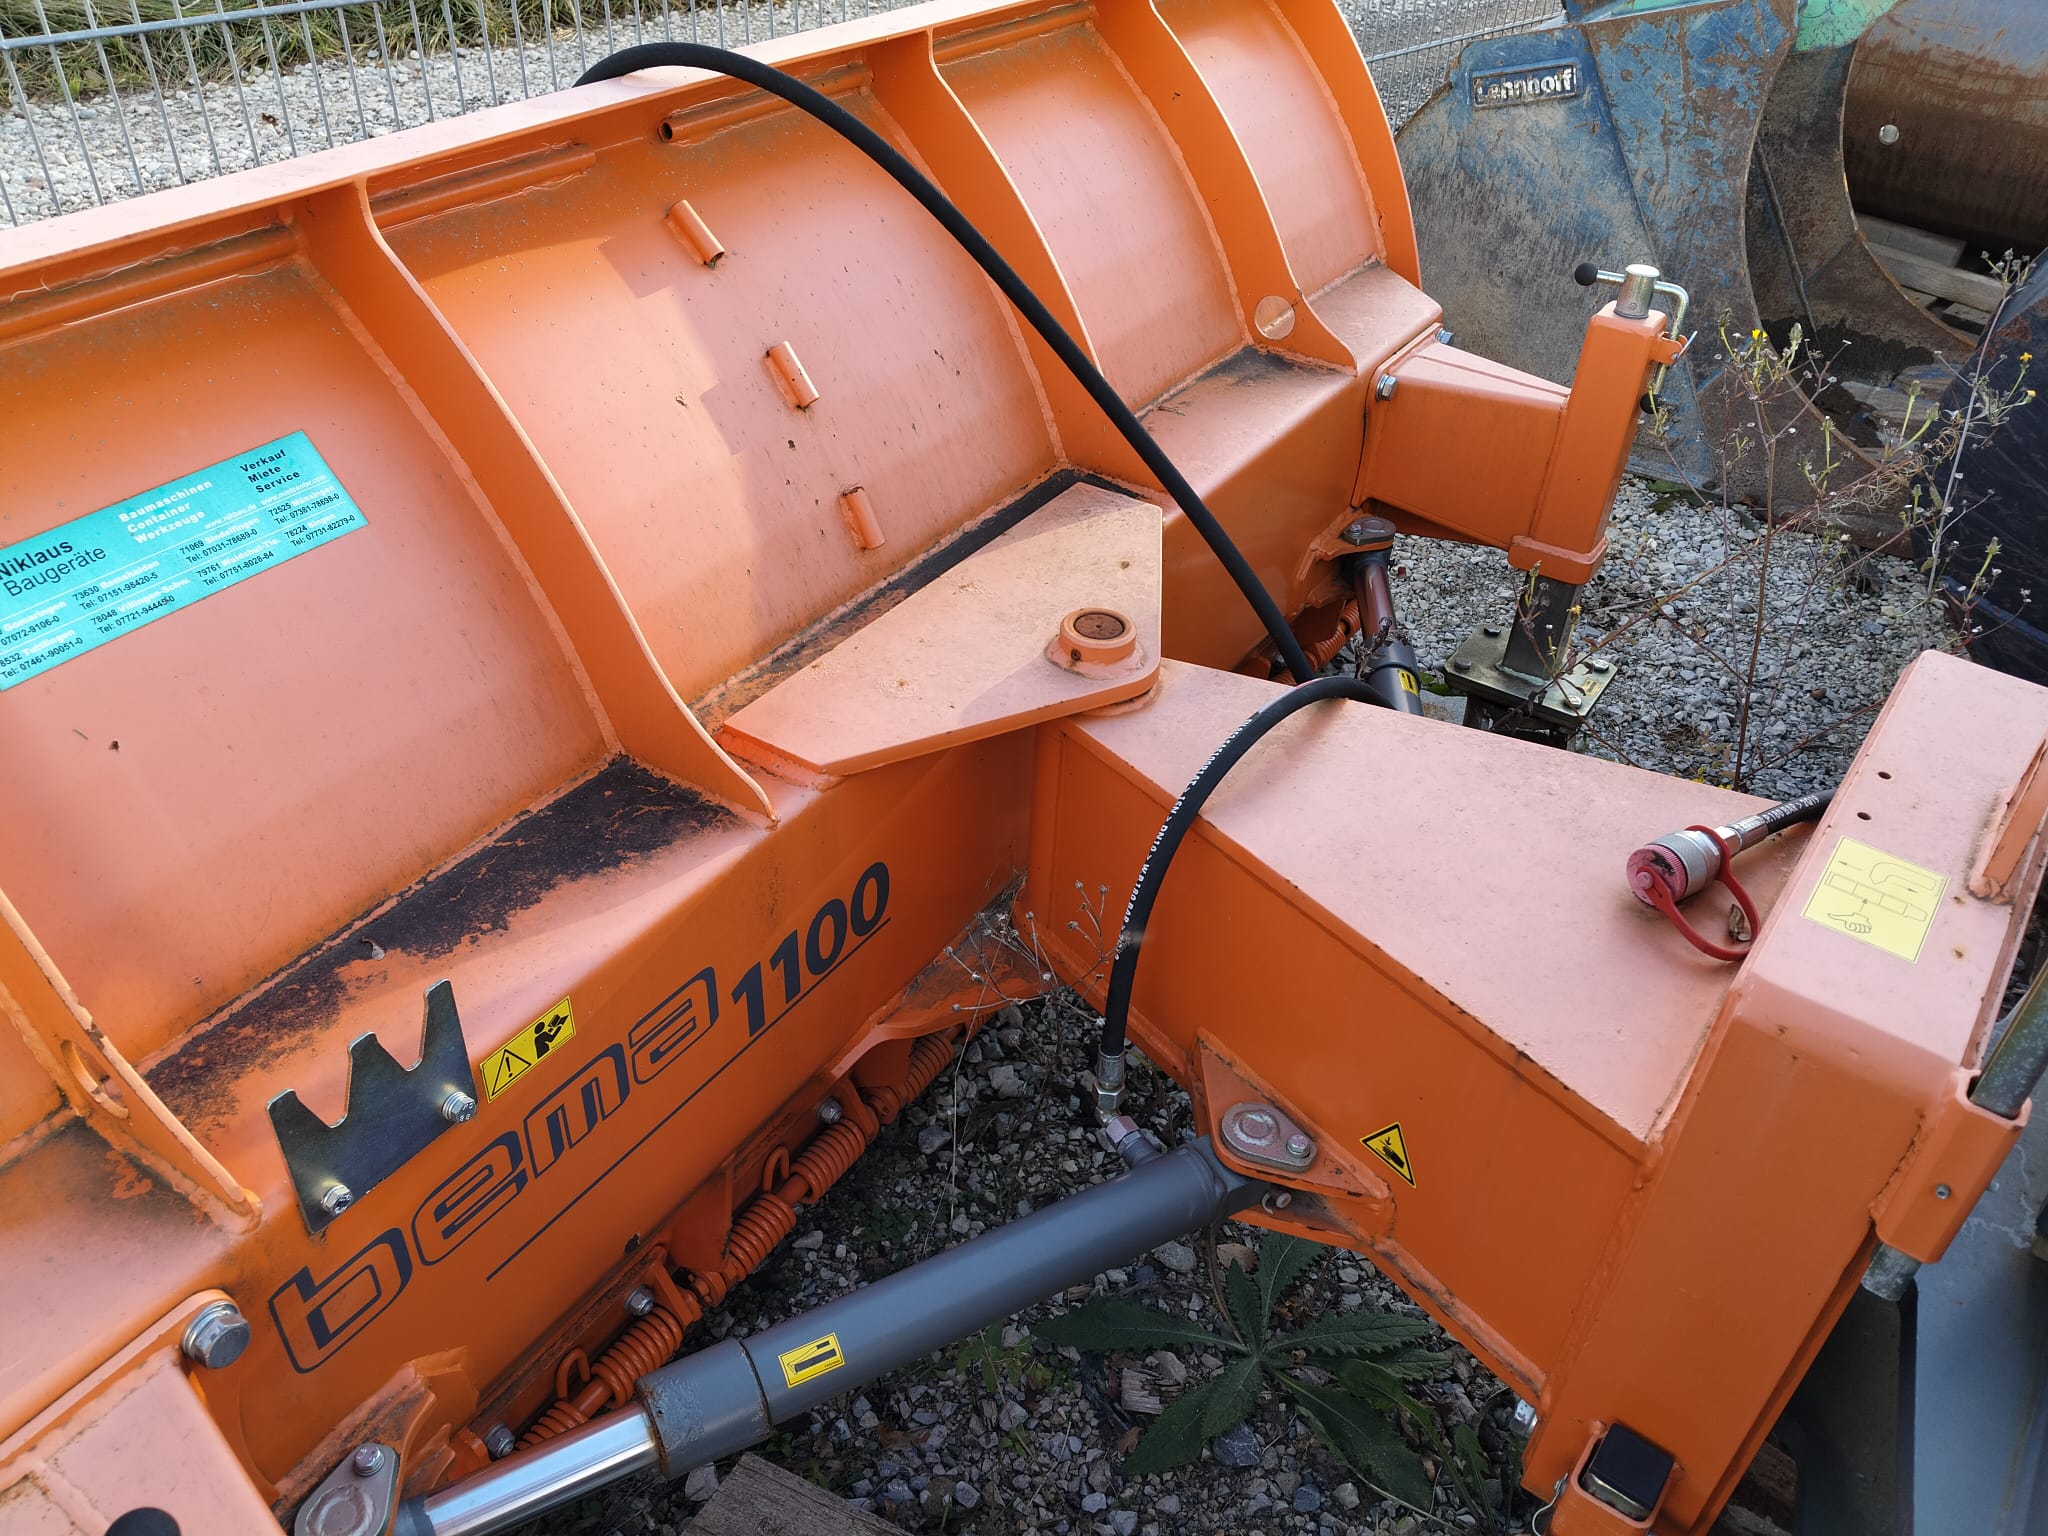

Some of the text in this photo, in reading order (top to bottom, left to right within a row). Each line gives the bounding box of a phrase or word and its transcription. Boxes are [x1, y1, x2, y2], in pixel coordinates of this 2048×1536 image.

[240, 449, 286, 473] Verkauf
[248, 466, 281, 483] Miete
[256, 471, 300, 493] Service
[119, 481, 212, 522] Baumaschinen
[268, 503, 292, 516] 72525
[128, 503, 190, 532] Container
[275, 515, 290, 525] Tel:
[134, 512, 204, 543] Werkzeuge
[290, 538, 305, 548] Tel:
[0, 541, 73, 580] Niklaus
[186, 554, 203, 564] Tel:
[3, 548, 106, 596] Baugeräte
[197, 562, 220, 578] 79761
[203, 576, 220, 586] Tel:
[73, 586, 100, 601] 73630
[80, 600, 98, 610] Tel:
[98, 623, 116, 634] Tel:
[1, 667, 19, 680] Tel:
[269, 862, 890, 1374] bema 1100
